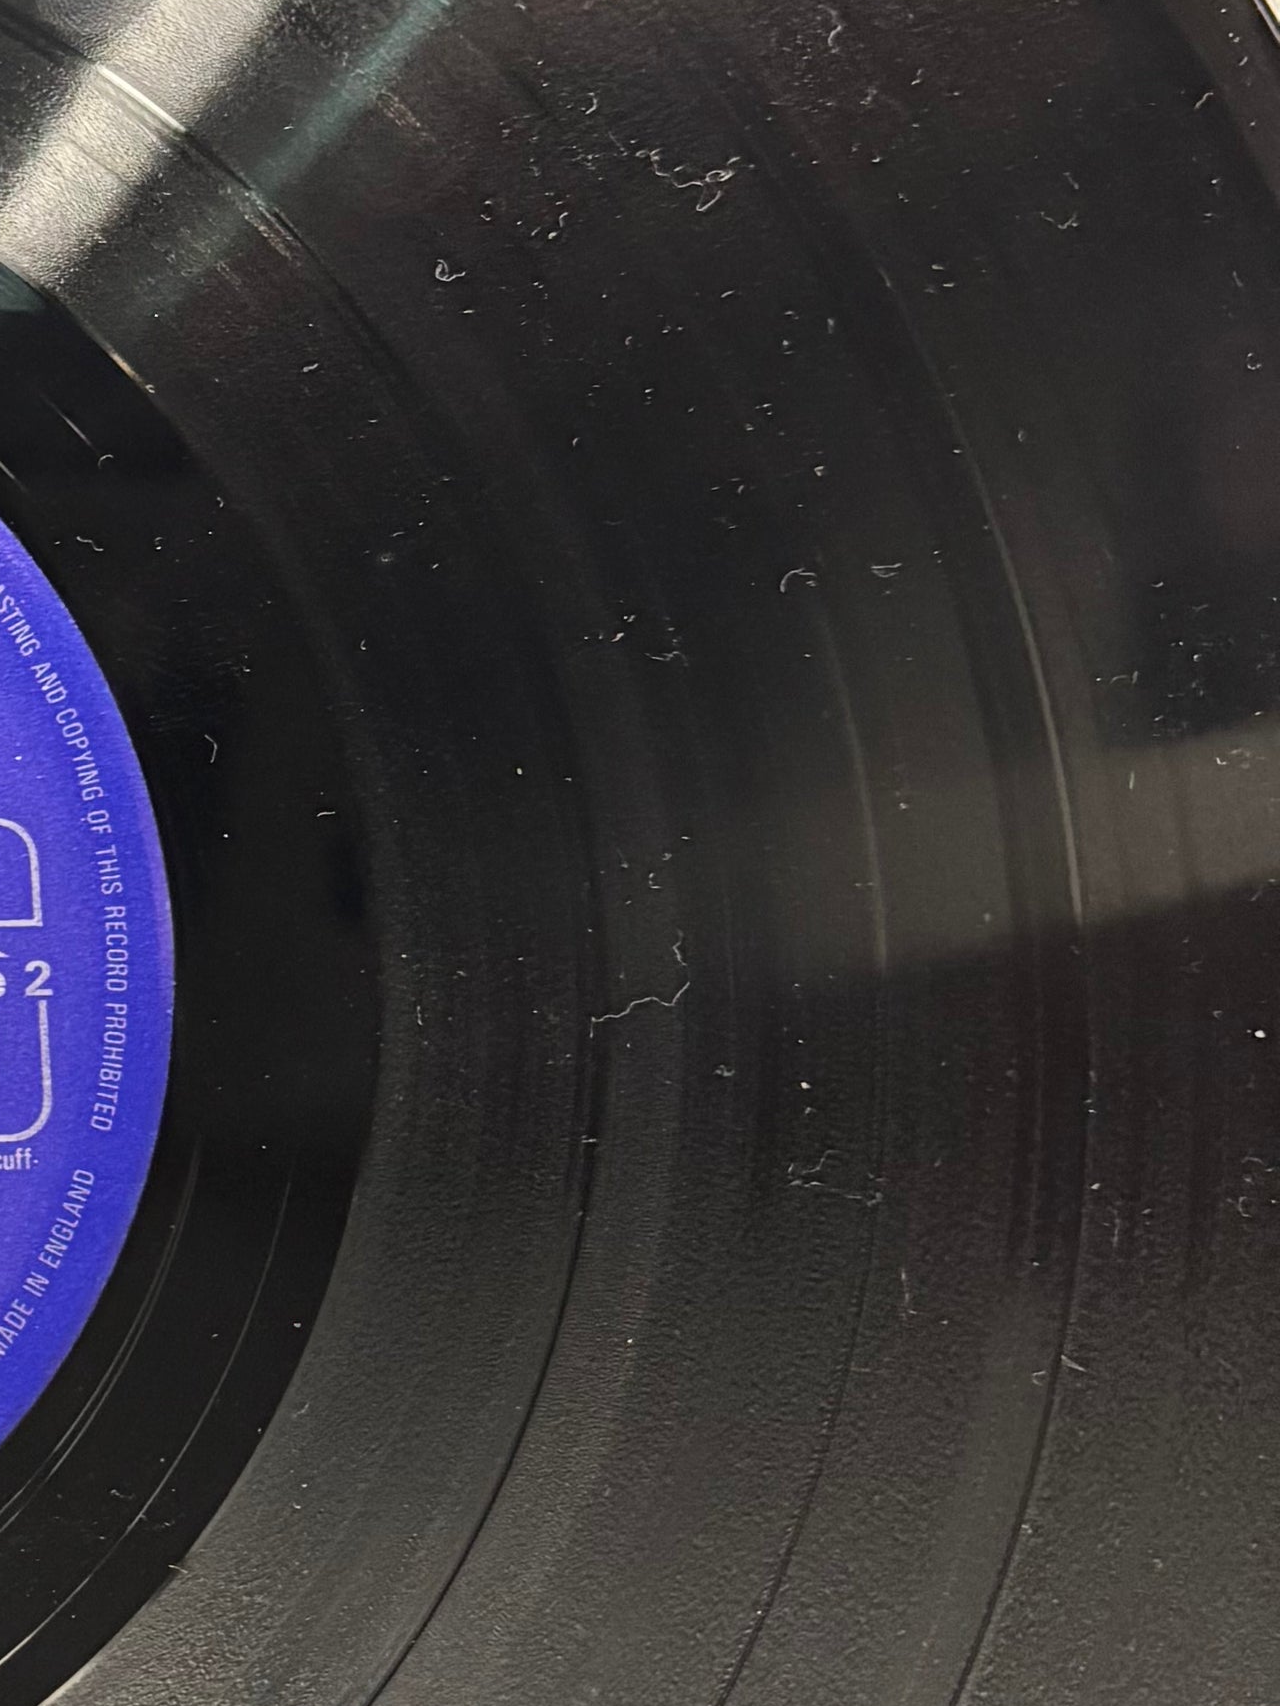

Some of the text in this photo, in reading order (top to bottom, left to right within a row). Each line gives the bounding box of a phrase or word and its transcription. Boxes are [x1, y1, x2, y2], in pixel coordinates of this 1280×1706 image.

[30, 658, 68, 705] AND
[51, 706, 104, 801] COPYING
[84, 807, 113, 836] OF
[93, 844, 122, 895] THIS
[24, 961, 53, 996] 2
[101, 904, 126, 991] RECORD
[89, 1002, 127, 1132] PROHIBITED
[22, 1271, 50, 1298] IN
[37, 1167, 95, 1269] ENGLAND
